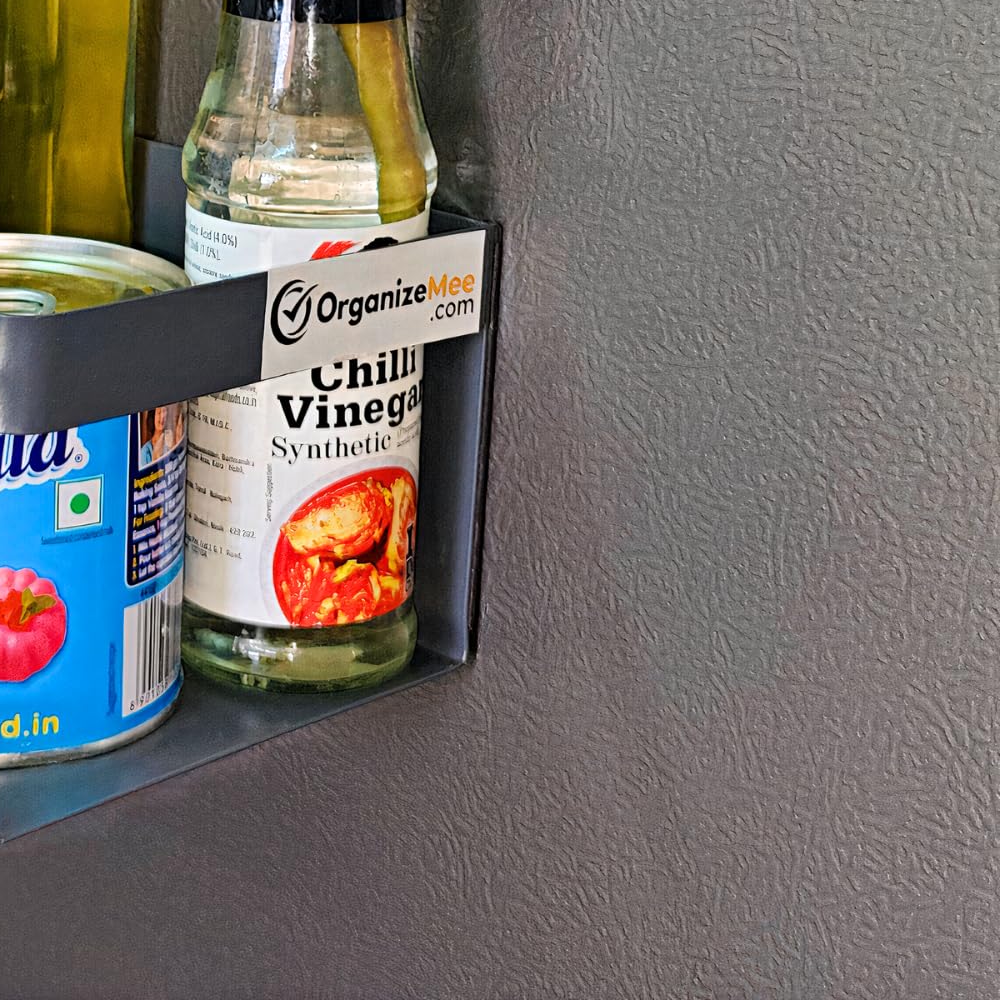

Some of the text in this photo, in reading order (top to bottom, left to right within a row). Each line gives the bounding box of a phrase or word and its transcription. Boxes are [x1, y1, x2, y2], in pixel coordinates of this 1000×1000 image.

[317, 273, 475, 326] OrganizeMee
[430, 298, 474, 321] .com
[311, 345, 416, 391] Chilli
[277, 380, 422, 427] Vinega
[272, 431, 391, 464] Synthetic
